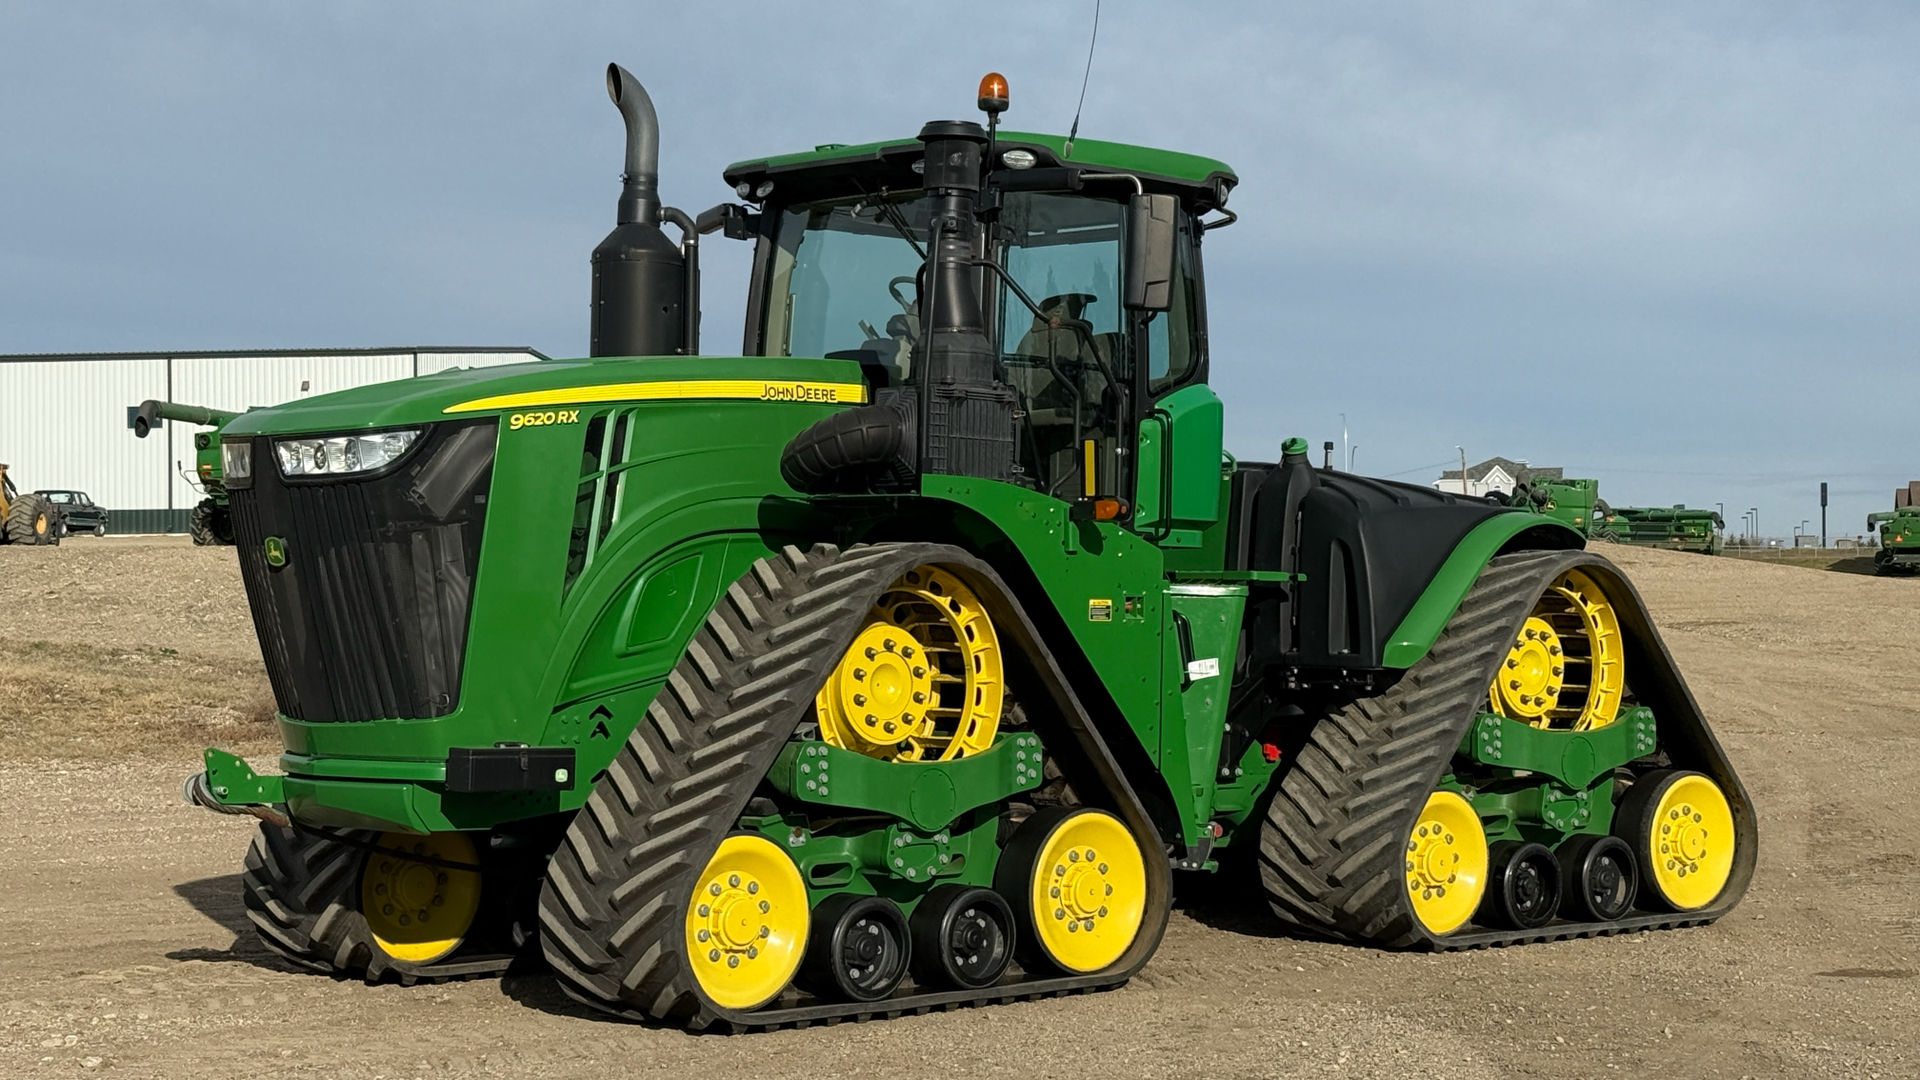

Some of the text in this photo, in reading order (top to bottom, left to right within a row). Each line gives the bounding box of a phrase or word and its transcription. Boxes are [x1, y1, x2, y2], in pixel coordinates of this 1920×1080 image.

[761, 384, 837, 401] JOHN DEERE
[510, 410, 580, 430] 9620 RX
